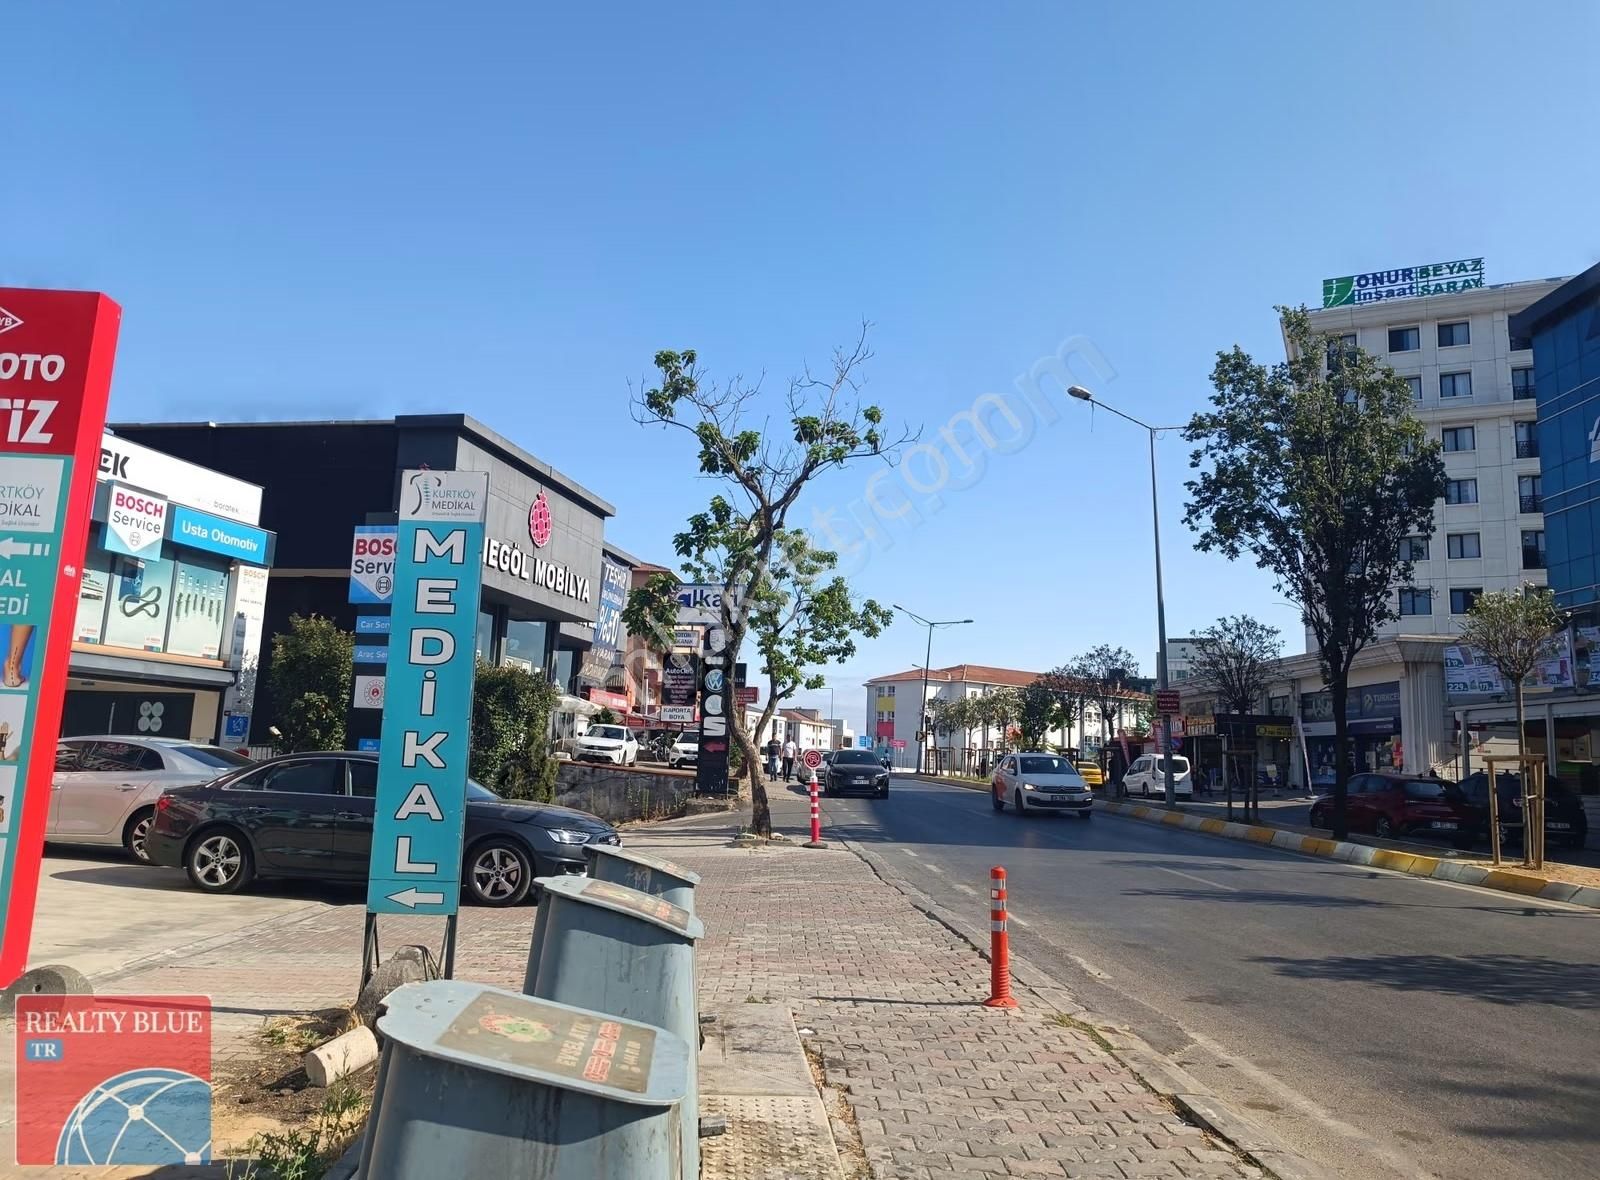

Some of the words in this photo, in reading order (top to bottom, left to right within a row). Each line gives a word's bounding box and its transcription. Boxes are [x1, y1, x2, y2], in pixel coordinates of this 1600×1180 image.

[1356, 267, 1415, 288] ONUR
[1419, 258, 1483, 280] BEYAZ
[1420, 277, 1483, 297] SARAY
[115, 491, 163, 518] BOSCH
[432, 488, 476, 500] KURTKÖY
[431, 500, 475, 511] MEDİKAL
[112, 509, 161, 534] Service
[181, 519, 208, 541] Usta
[211, 528, 259, 552] Otomotiv
[0, 568, 27, 588] AL
[534, 557, 590, 604] MOBİLYA
[360, 620, 377, 630] Car
[598, 604, 620, 646] %50
[393, 528, 467, 875] MEDİKAL
